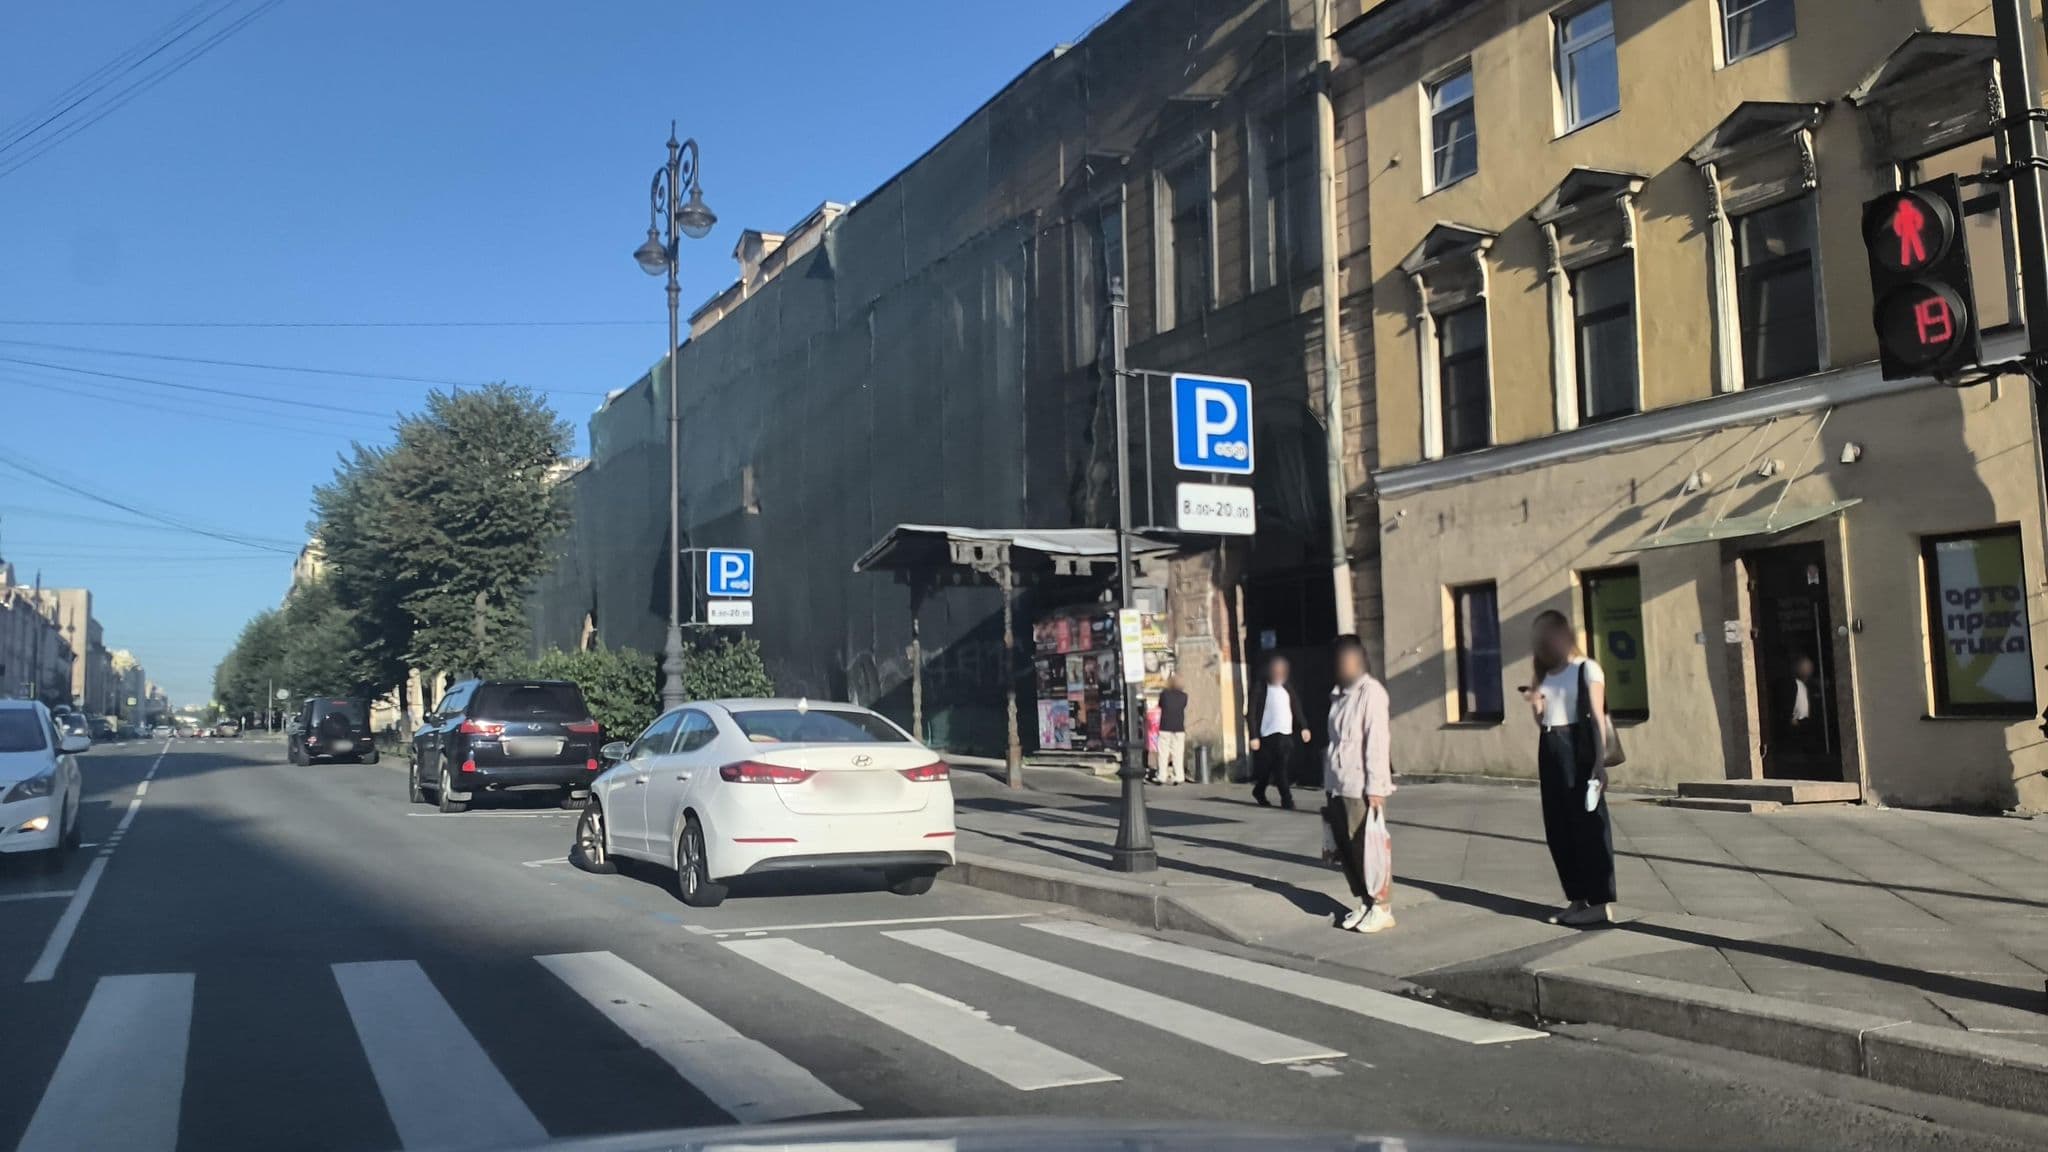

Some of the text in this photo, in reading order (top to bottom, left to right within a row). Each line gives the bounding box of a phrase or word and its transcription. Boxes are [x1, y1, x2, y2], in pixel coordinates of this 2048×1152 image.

[1915, 296, 1952, 344] 19
[1195, 387, 1238, 459] P
[720, 555, 744, 590] P
